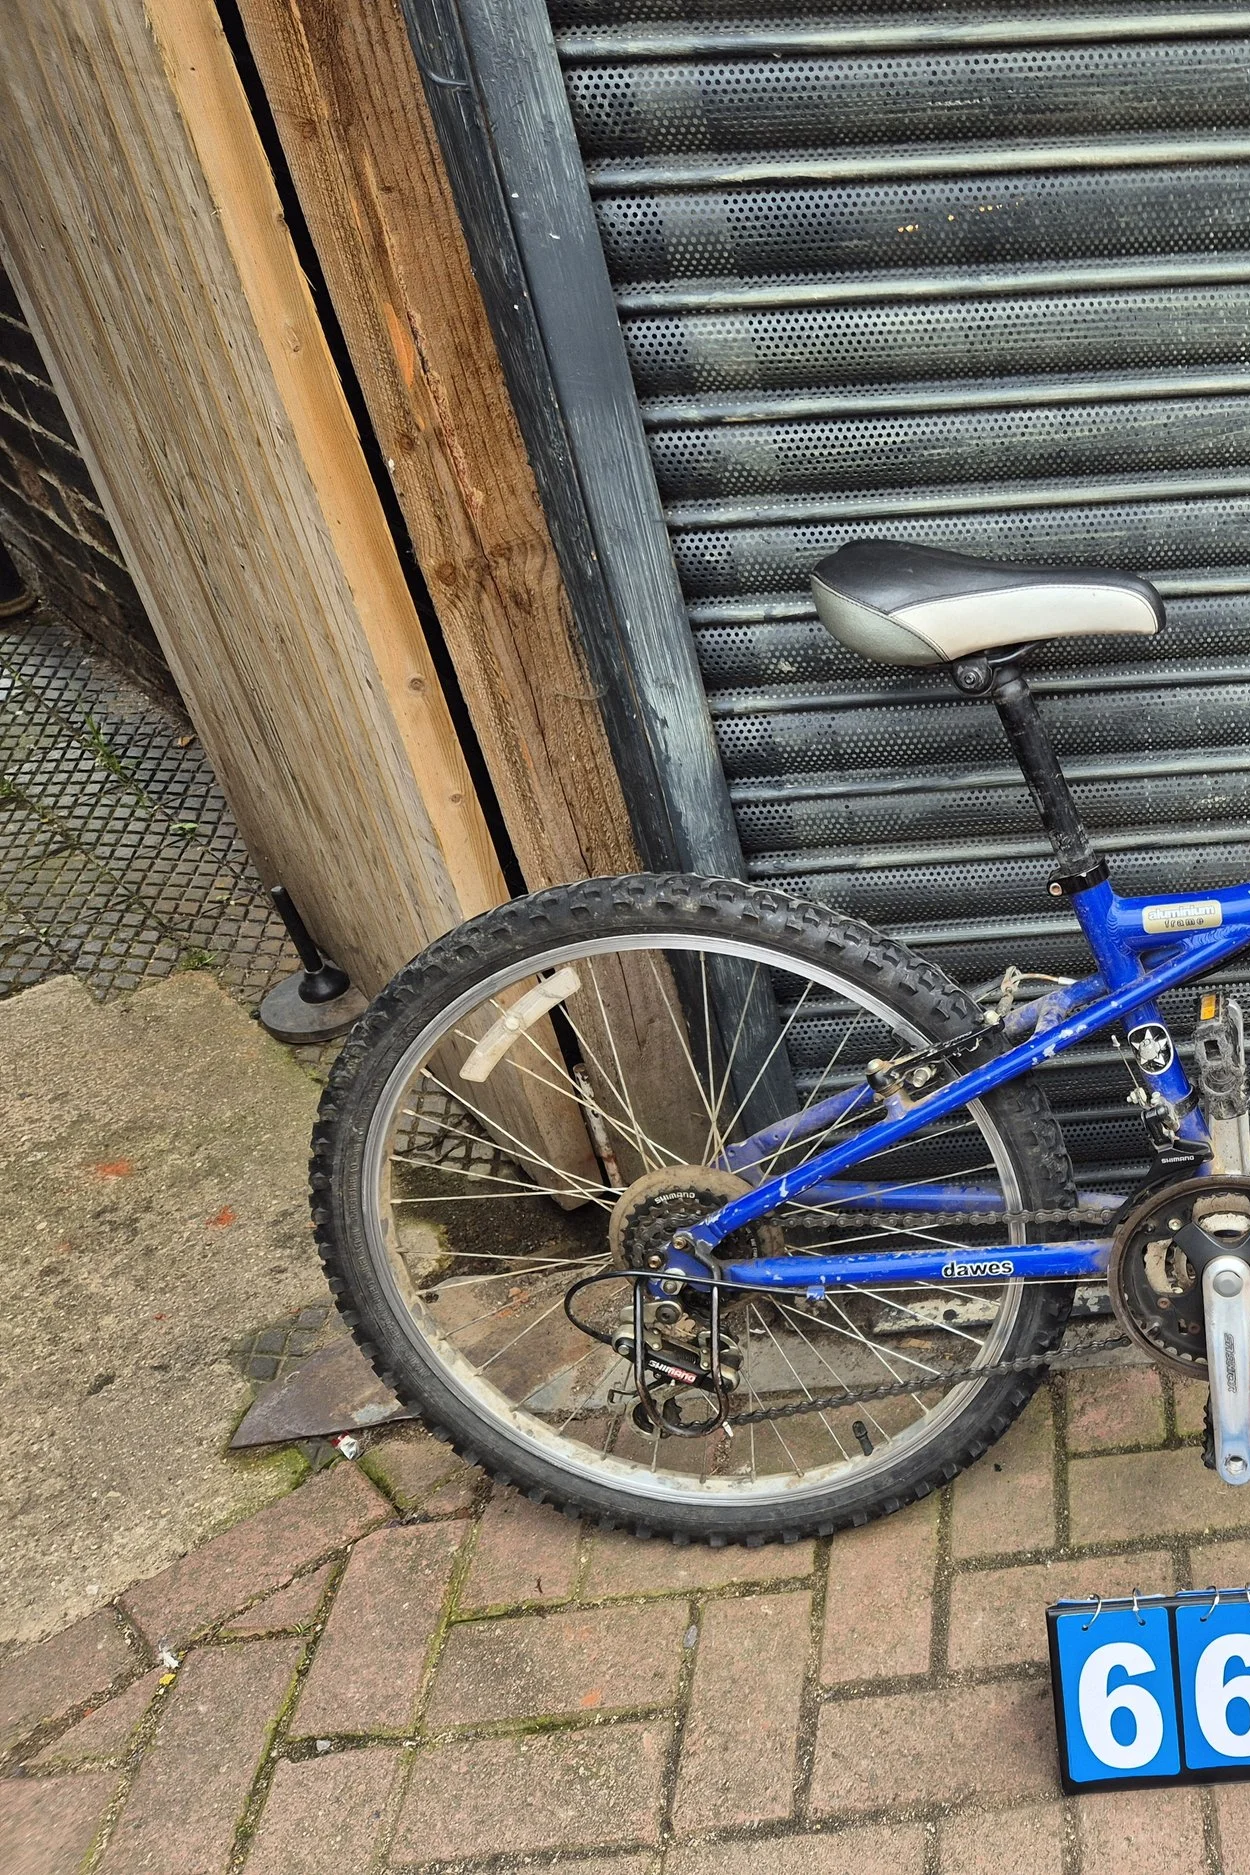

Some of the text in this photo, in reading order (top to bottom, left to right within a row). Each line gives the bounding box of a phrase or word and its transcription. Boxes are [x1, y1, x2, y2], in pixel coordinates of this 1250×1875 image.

[1148, 905, 1215, 920] aluminium
[654, 1191, 696, 1205] SHIMANO
[943, 1261, 1013, 1278] dawes
[648, 1359, 697, 1383] SHIMANO
